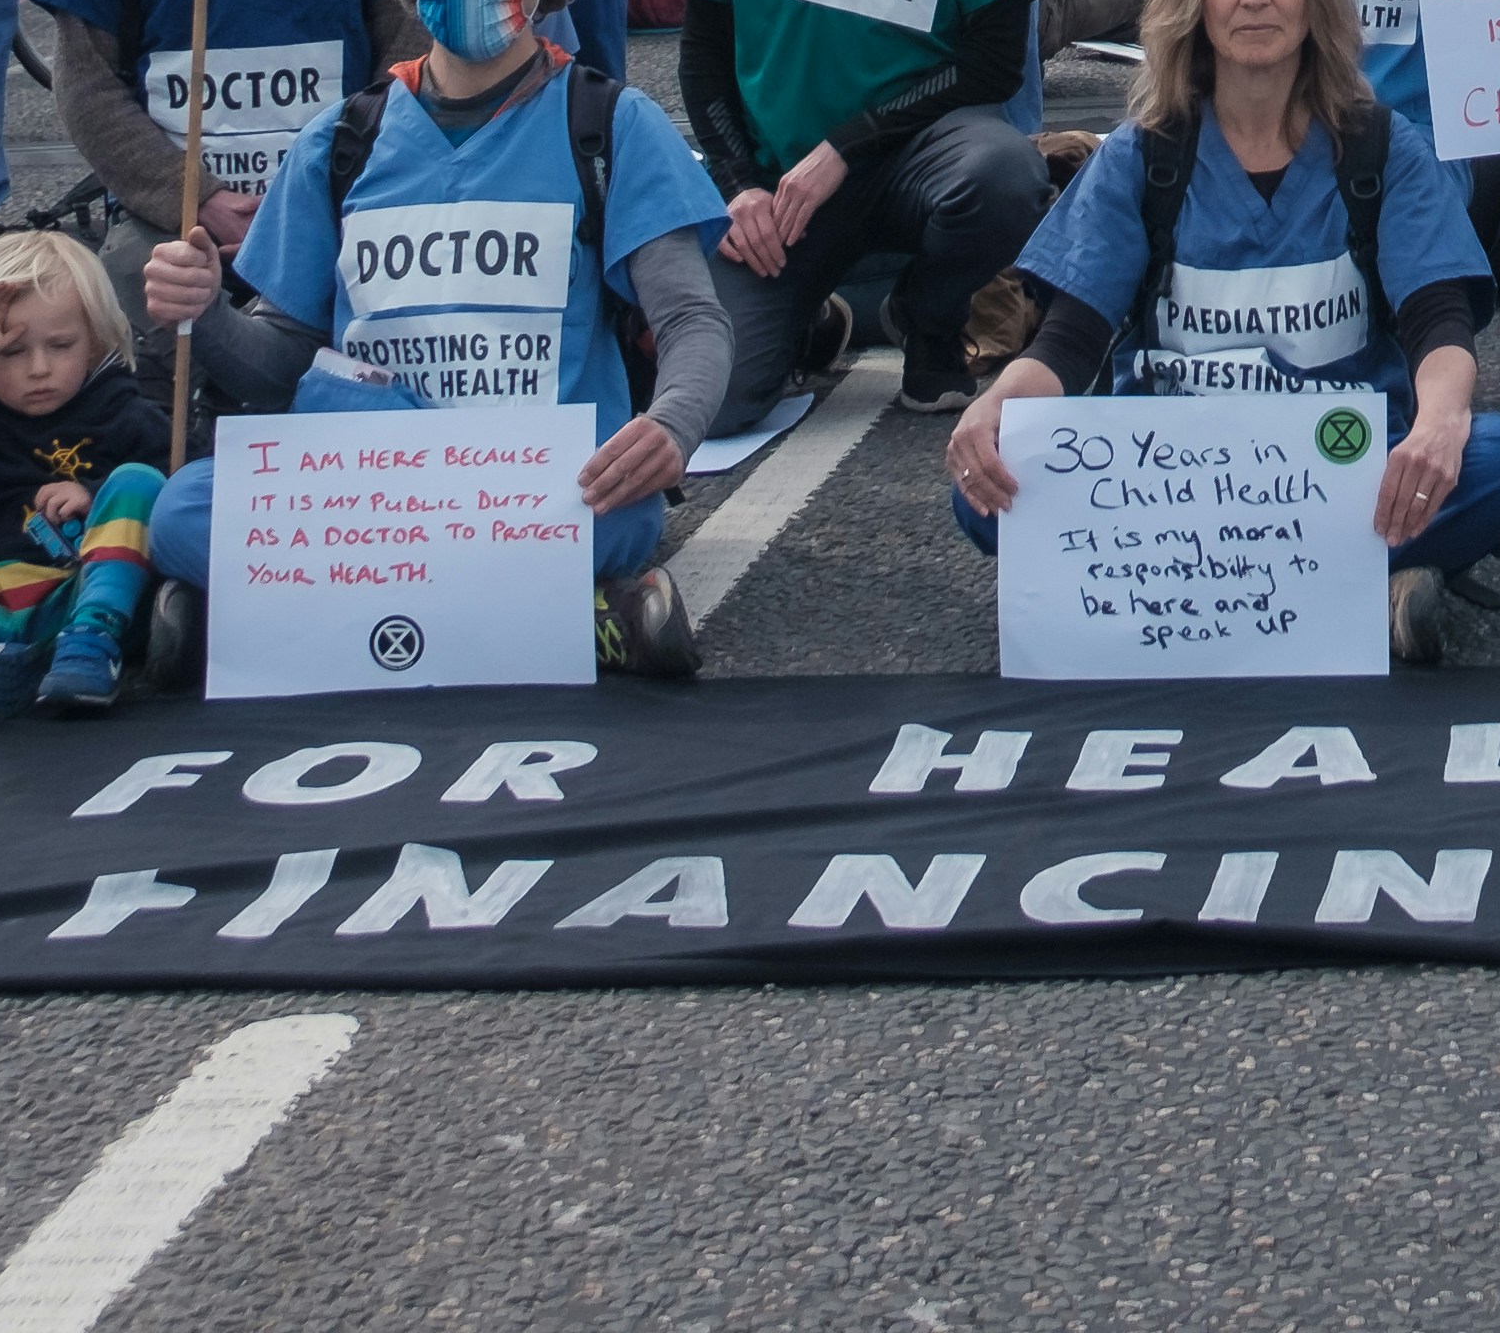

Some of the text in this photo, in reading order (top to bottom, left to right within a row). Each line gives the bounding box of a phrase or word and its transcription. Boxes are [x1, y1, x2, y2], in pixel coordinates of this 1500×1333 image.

[357, 230, 539, 284] DOCTOR
[1167, 286, 1361, 334] PAEDIATRICIAN
[500, 334, 551, 361] FOR
[440, 368, 538, 398] HEALTH
[248, 441, 551, 474] I AM HERE BECAUSE
[1045, 427, 1287, 473] 30 Years in
[252, 494, 276, 511] IT
[289, 494, 313, 511] IS
[323, 494, 361, 509] MY
[477, 489, 548, 510] DUTY
[1090, 469, 1328, 509] Child Health
[246, 528, 280, 549] AS
[290, 528, 309, 549] A
[325, 525, 429, 547] DOCTOR
[1059, 519, 1303, 568] It is my moral
[1289, 554, 1319, 575] to
[1081, 586, 1202, 617] be here
[1140, 621, 1232, 649] speak
[70, 740, 600, 819] FOR
